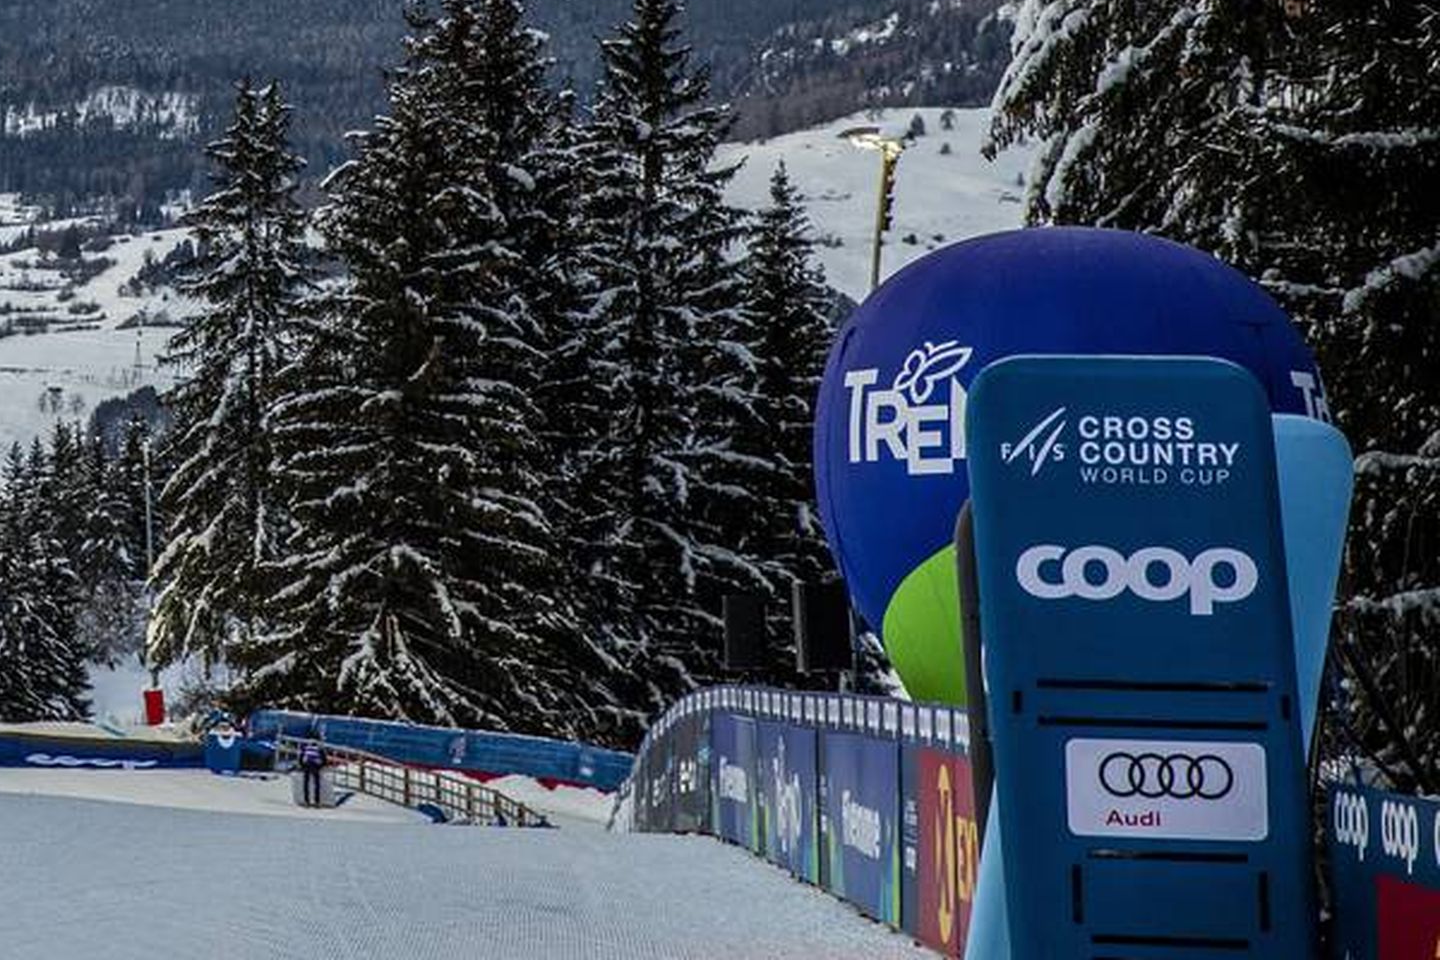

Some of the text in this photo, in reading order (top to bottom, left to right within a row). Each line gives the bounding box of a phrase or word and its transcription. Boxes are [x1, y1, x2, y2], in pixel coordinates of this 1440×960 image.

[1078, 416, 1195, 440] CROSS
[1079, 442, 1240, 466] COUNTRY
[1080, 468, 1231, 485] WORLD CUP
[1016, 544, 1259, 616] coop
[1105, 809, 1161, 827] Audi
[1334, 791, 1369, 862] coop
[1381, 799, 1419, 875] coop
